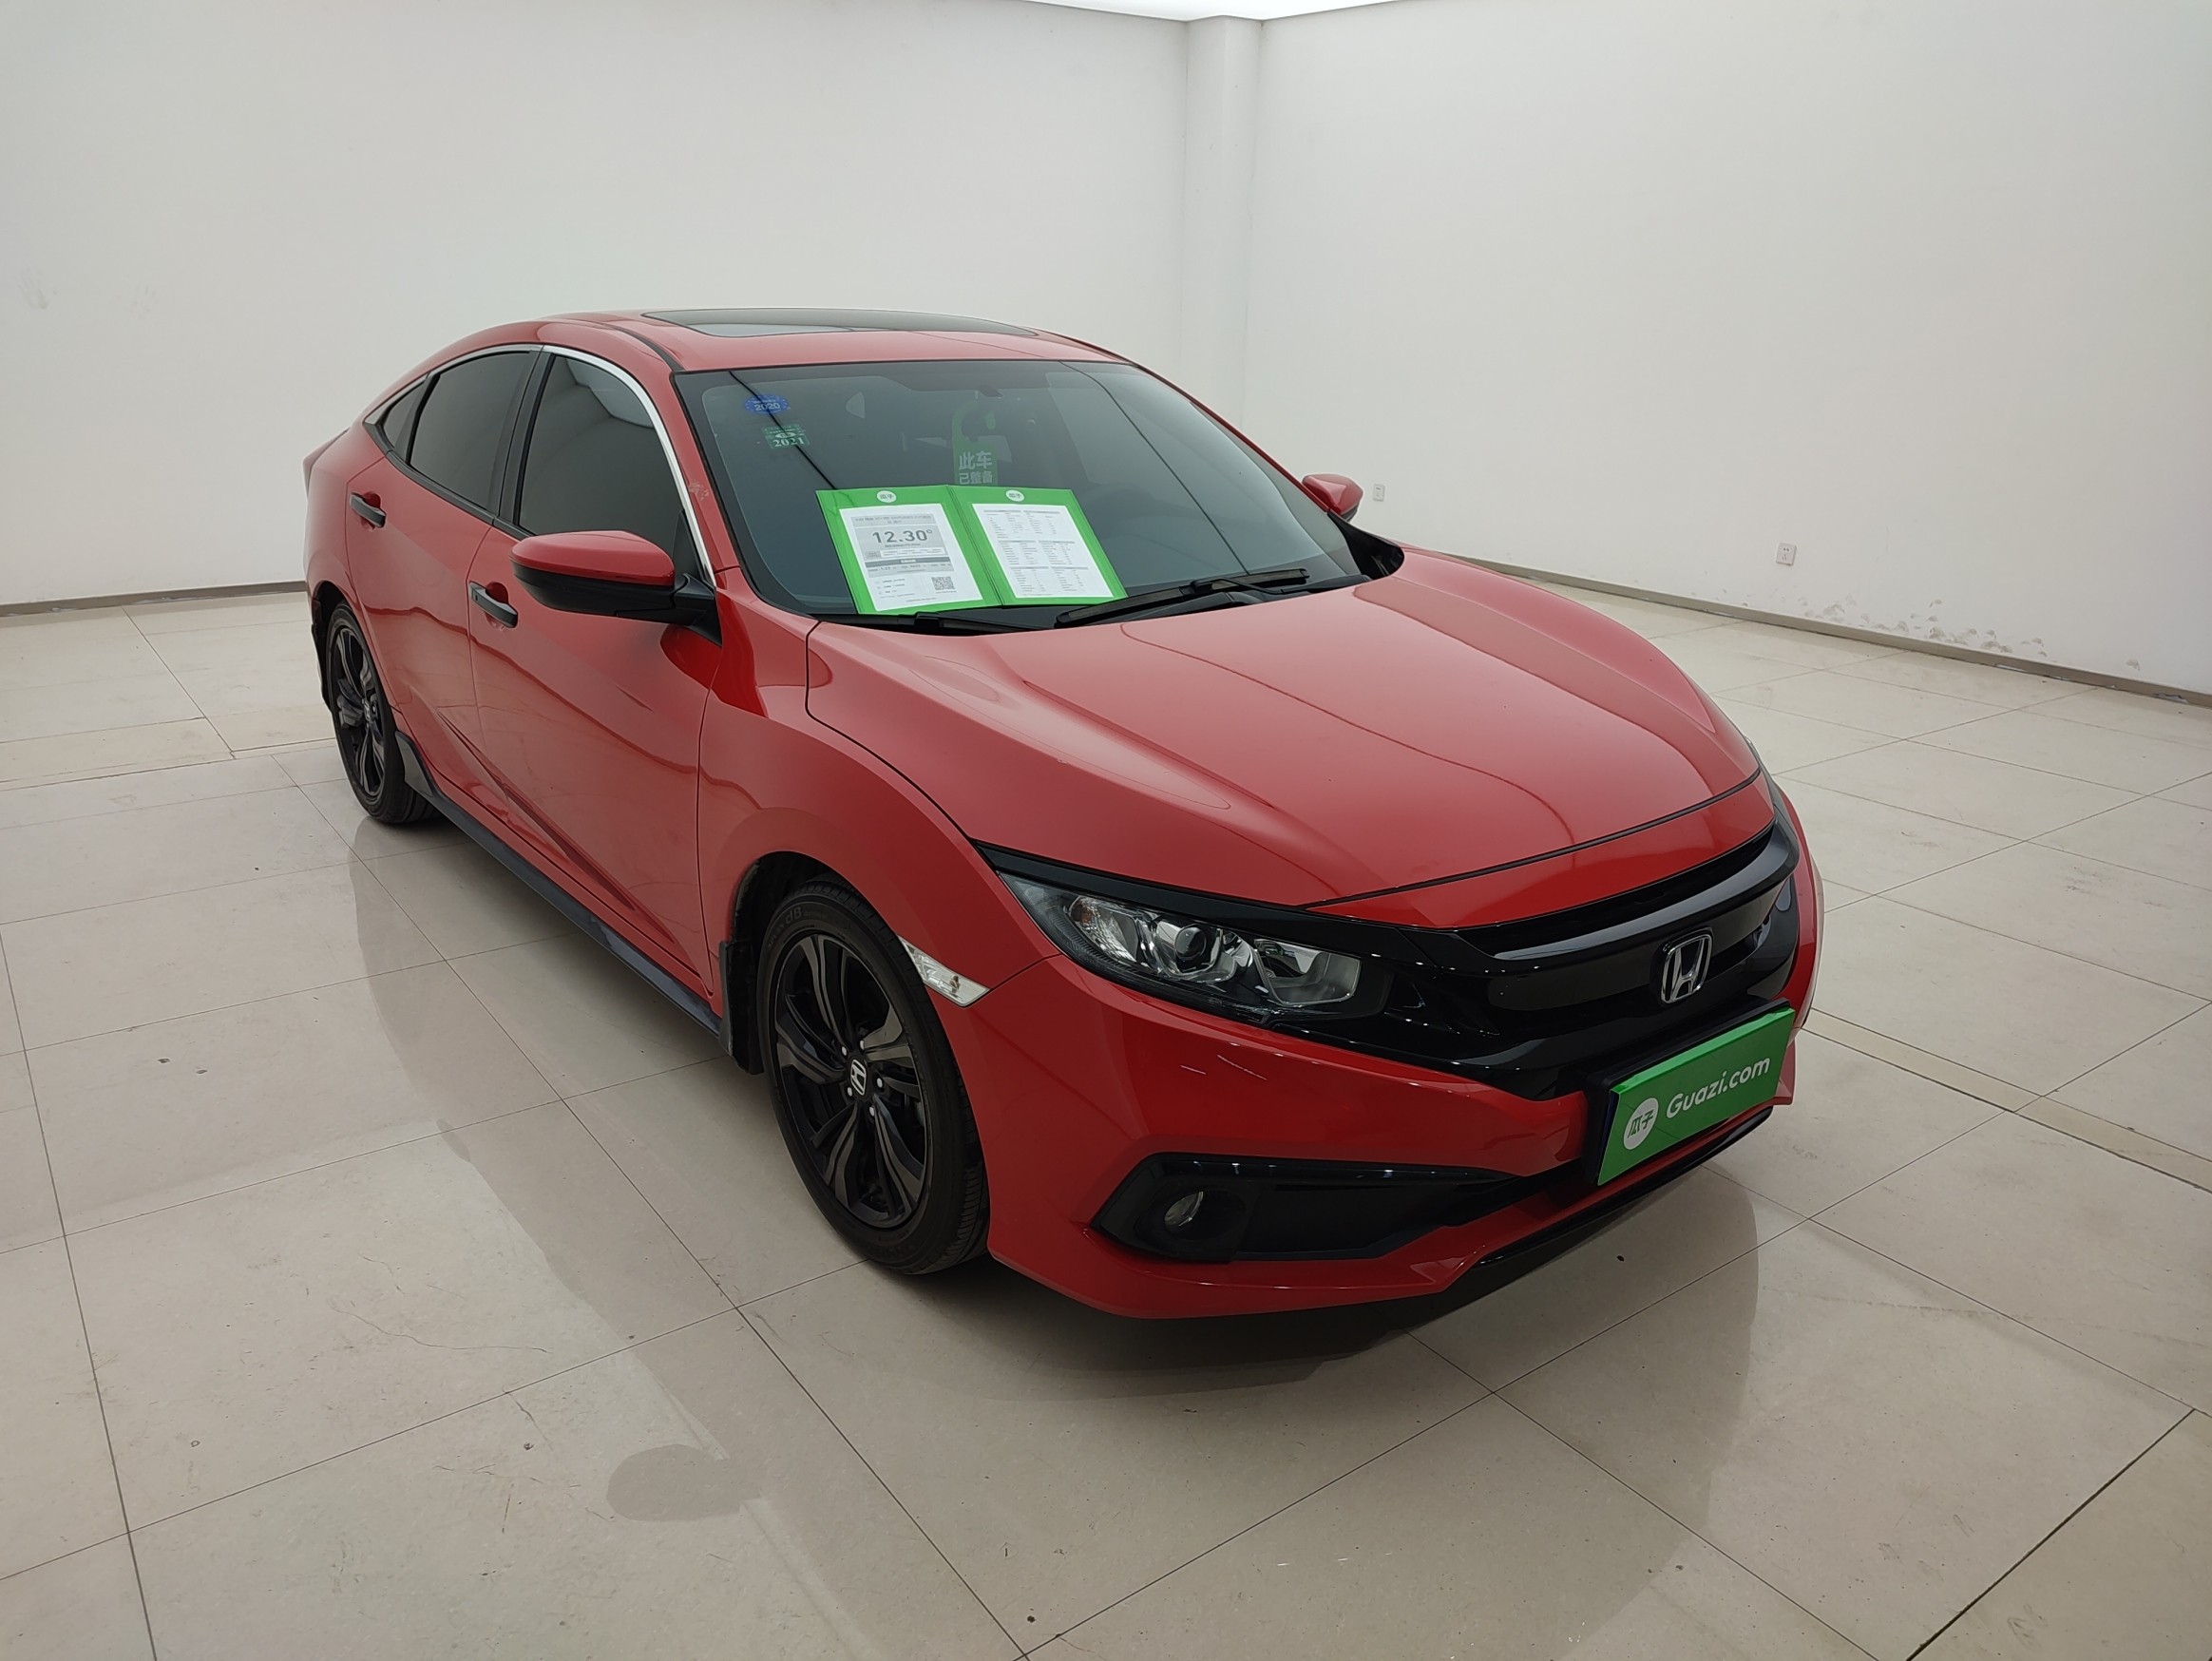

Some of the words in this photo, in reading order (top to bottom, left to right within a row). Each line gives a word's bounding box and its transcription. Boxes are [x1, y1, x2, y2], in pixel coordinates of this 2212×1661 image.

[772, 437, 805, 448] 2021
[959, 450, 993, 470] 此车
[959, 470, 993, 485] 已整备
[1666, 1058, 1770, 1118] Guazi.com
[1627, 1110, 1654, 1138] 瓜子
